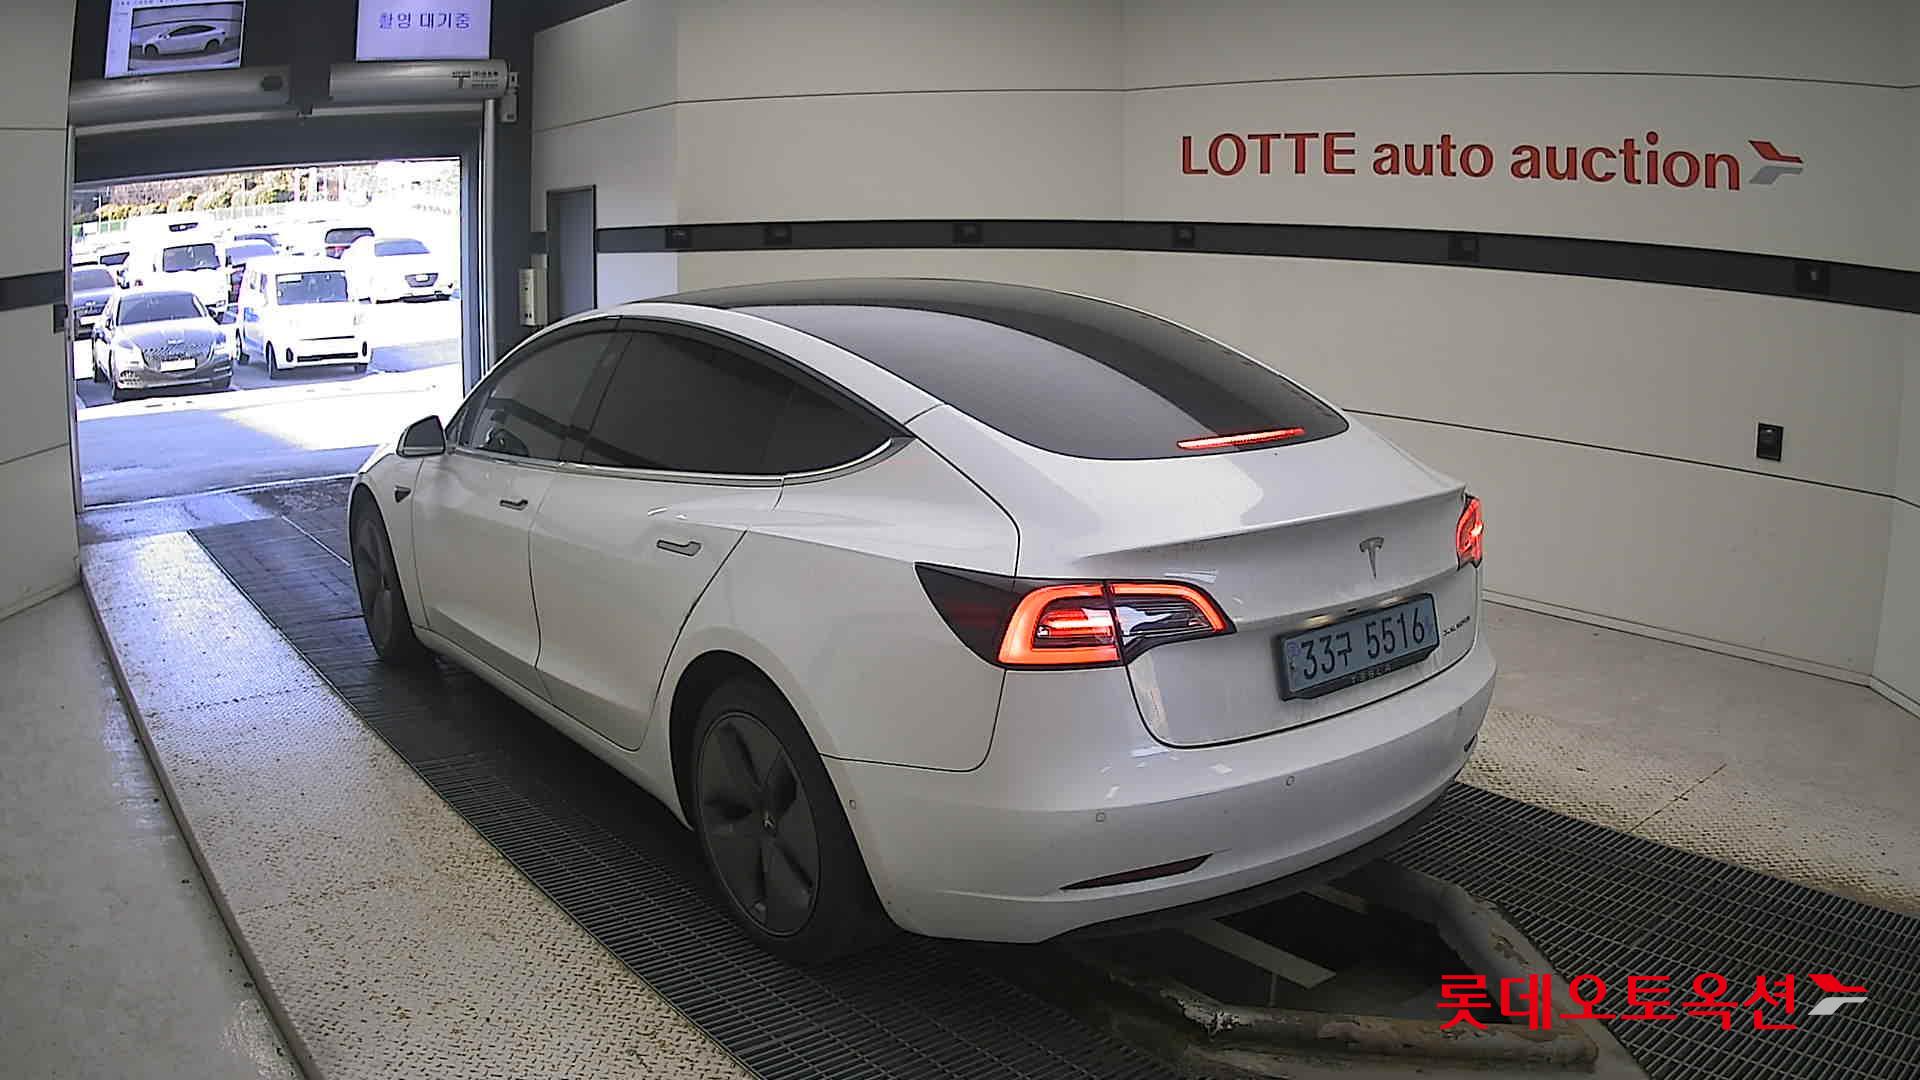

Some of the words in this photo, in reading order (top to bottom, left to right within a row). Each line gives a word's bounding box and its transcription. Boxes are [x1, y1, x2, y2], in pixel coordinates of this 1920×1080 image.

[419, 12, 470, 29] 대기중
[1182, 132, 1356, 176] LOTTE
[1372, 134, 1494, 178] auto
[1509, 131, 1741, 191] auction
[1301, 631, 1353, 680] 33구
[1366, 607, 1425, 659] 5516
